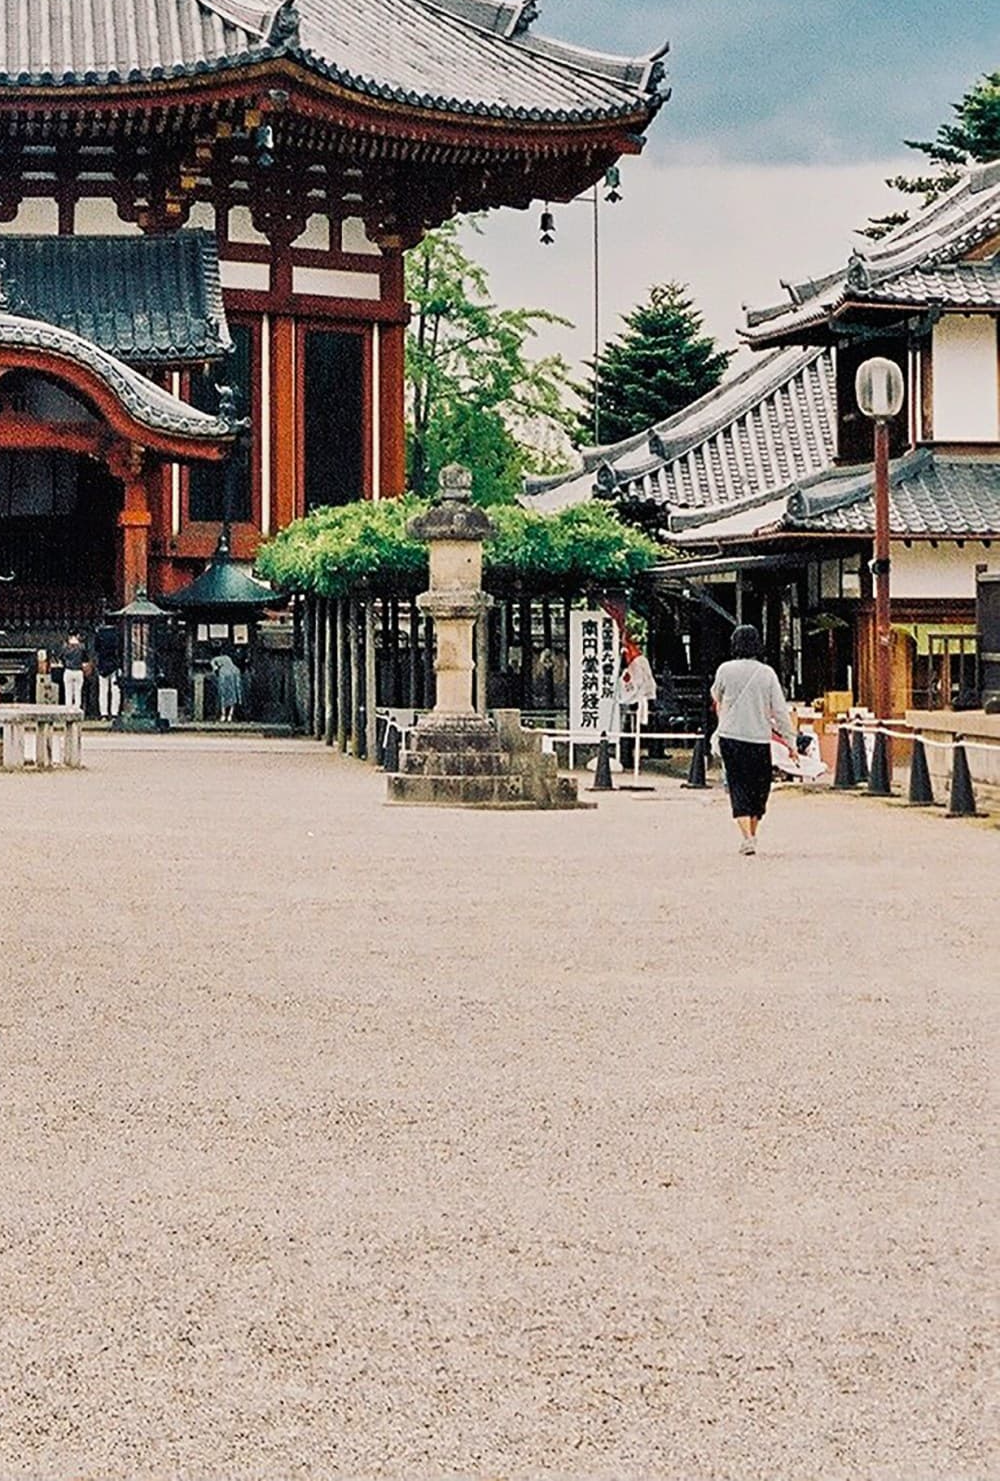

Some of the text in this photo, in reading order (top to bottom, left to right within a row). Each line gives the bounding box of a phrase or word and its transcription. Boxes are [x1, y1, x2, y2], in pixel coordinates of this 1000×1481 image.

[581, 619, 600, 728] 南円堂納経所
